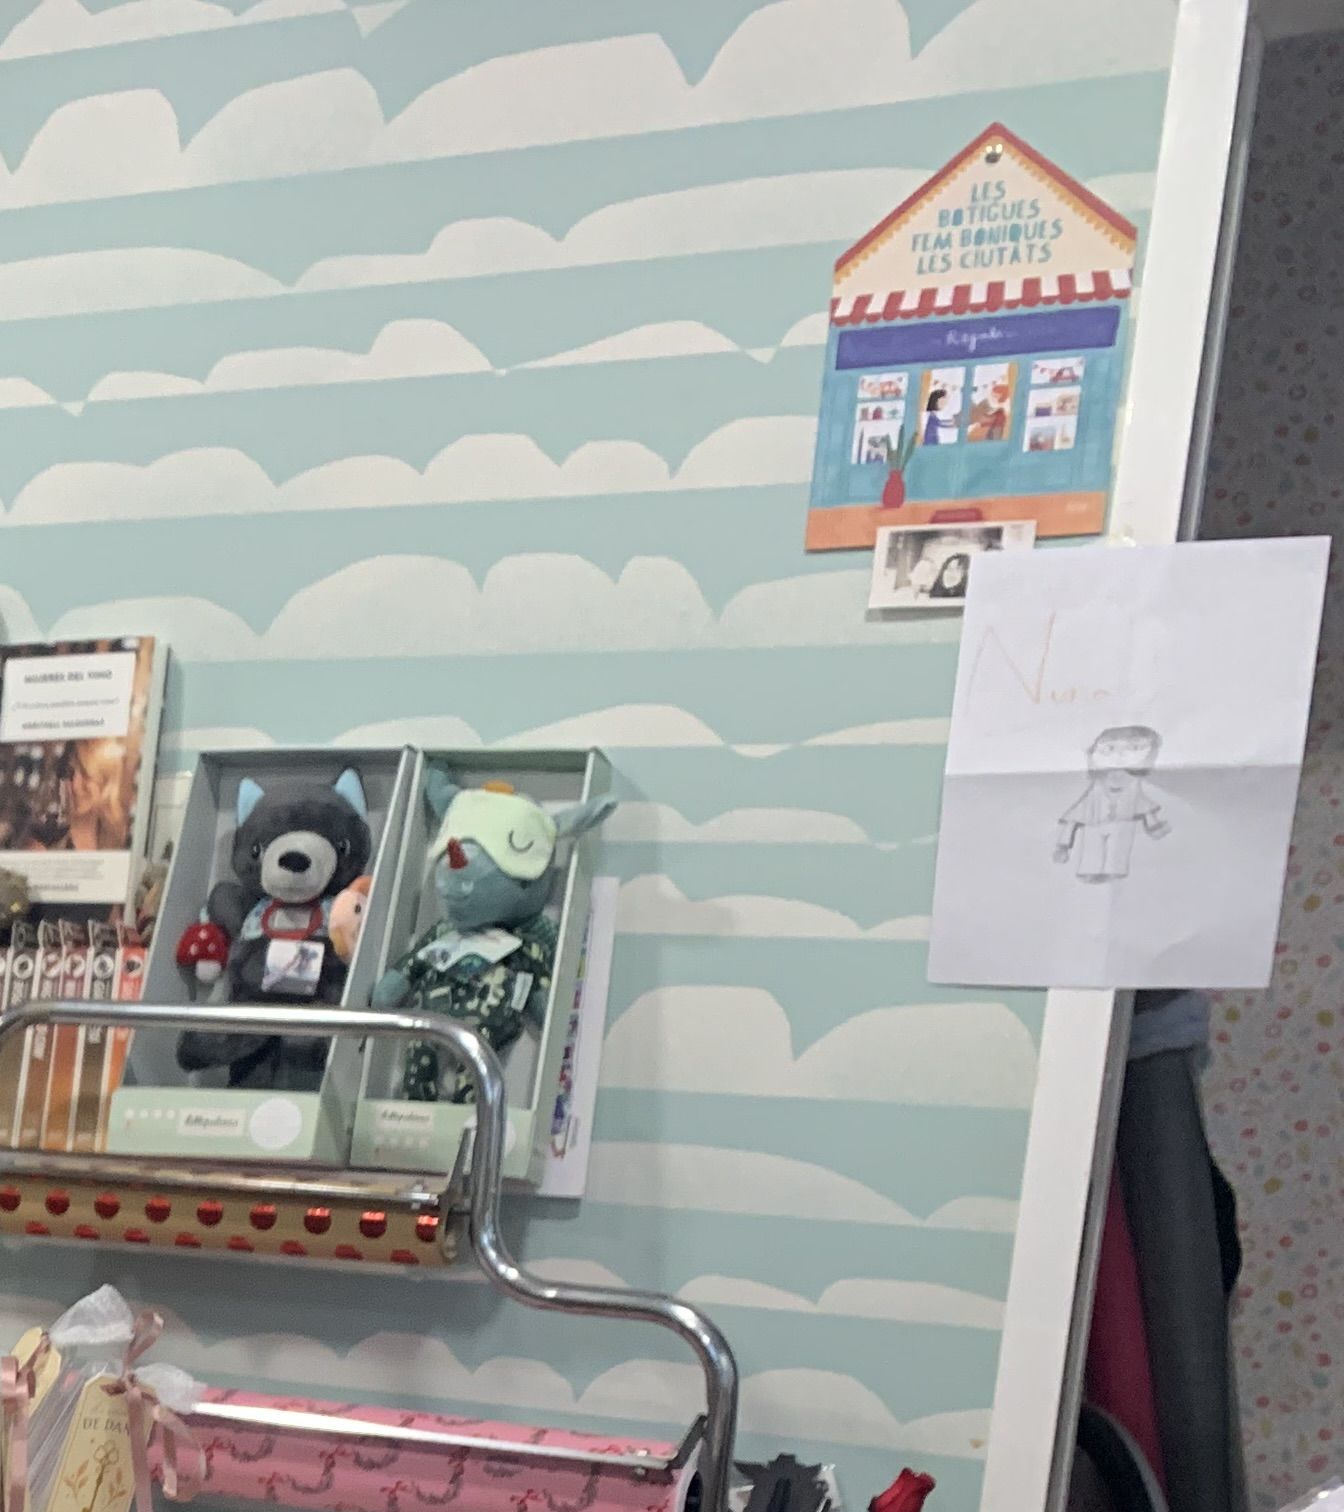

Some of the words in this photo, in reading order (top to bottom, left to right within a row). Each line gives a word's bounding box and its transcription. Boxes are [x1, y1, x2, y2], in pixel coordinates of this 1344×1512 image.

[970, 180, 1006, 203] LES
[938, 198, 1041, 229] BOTIGUES
[911, 232, 953, 252] FEM
[960, 218, 1064, 248] BONIQUES
[916, 253, 953, 275] LES
[959, 242, 1053, 269] CIUTATS
